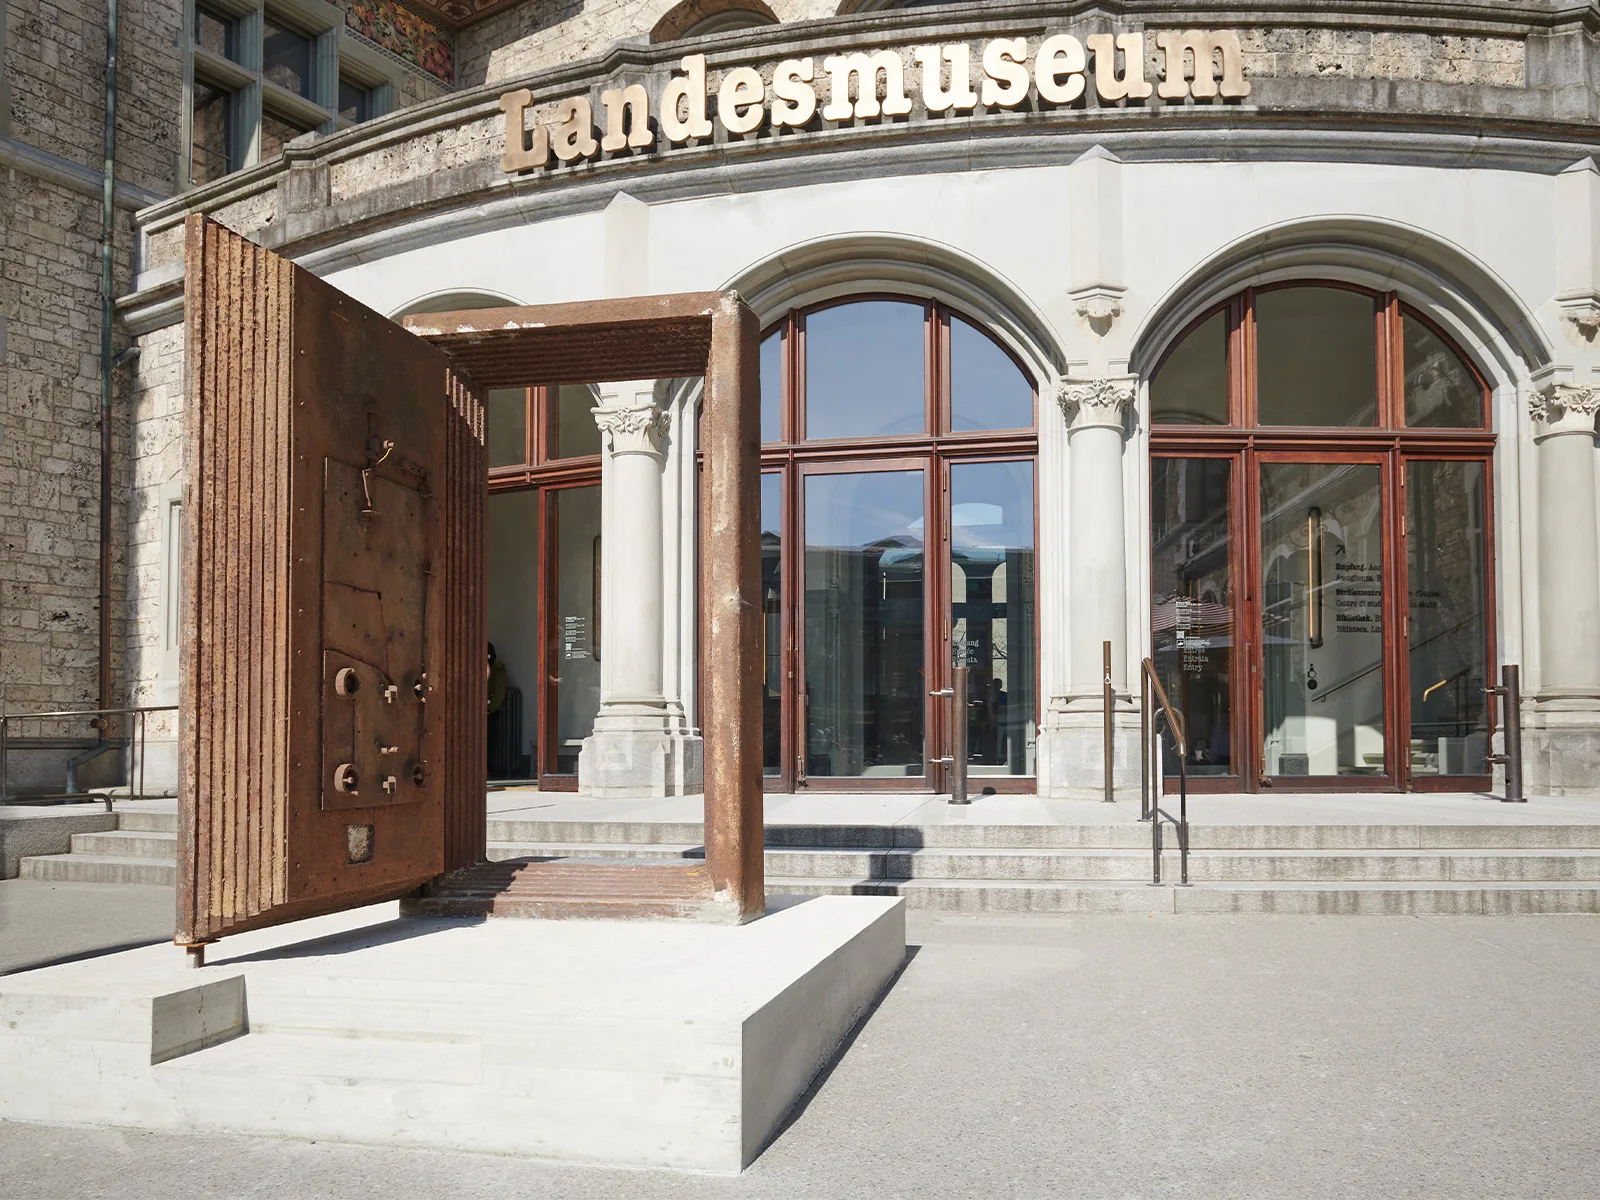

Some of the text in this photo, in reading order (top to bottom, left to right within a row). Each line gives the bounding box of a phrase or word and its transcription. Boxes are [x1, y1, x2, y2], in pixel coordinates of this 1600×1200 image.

[500, 29, 1251, 173] Landesmuseum
[1336, 613, 1373, 622] Bibliothek.
[1336, 625, 1370, 633] Biblioteca.
